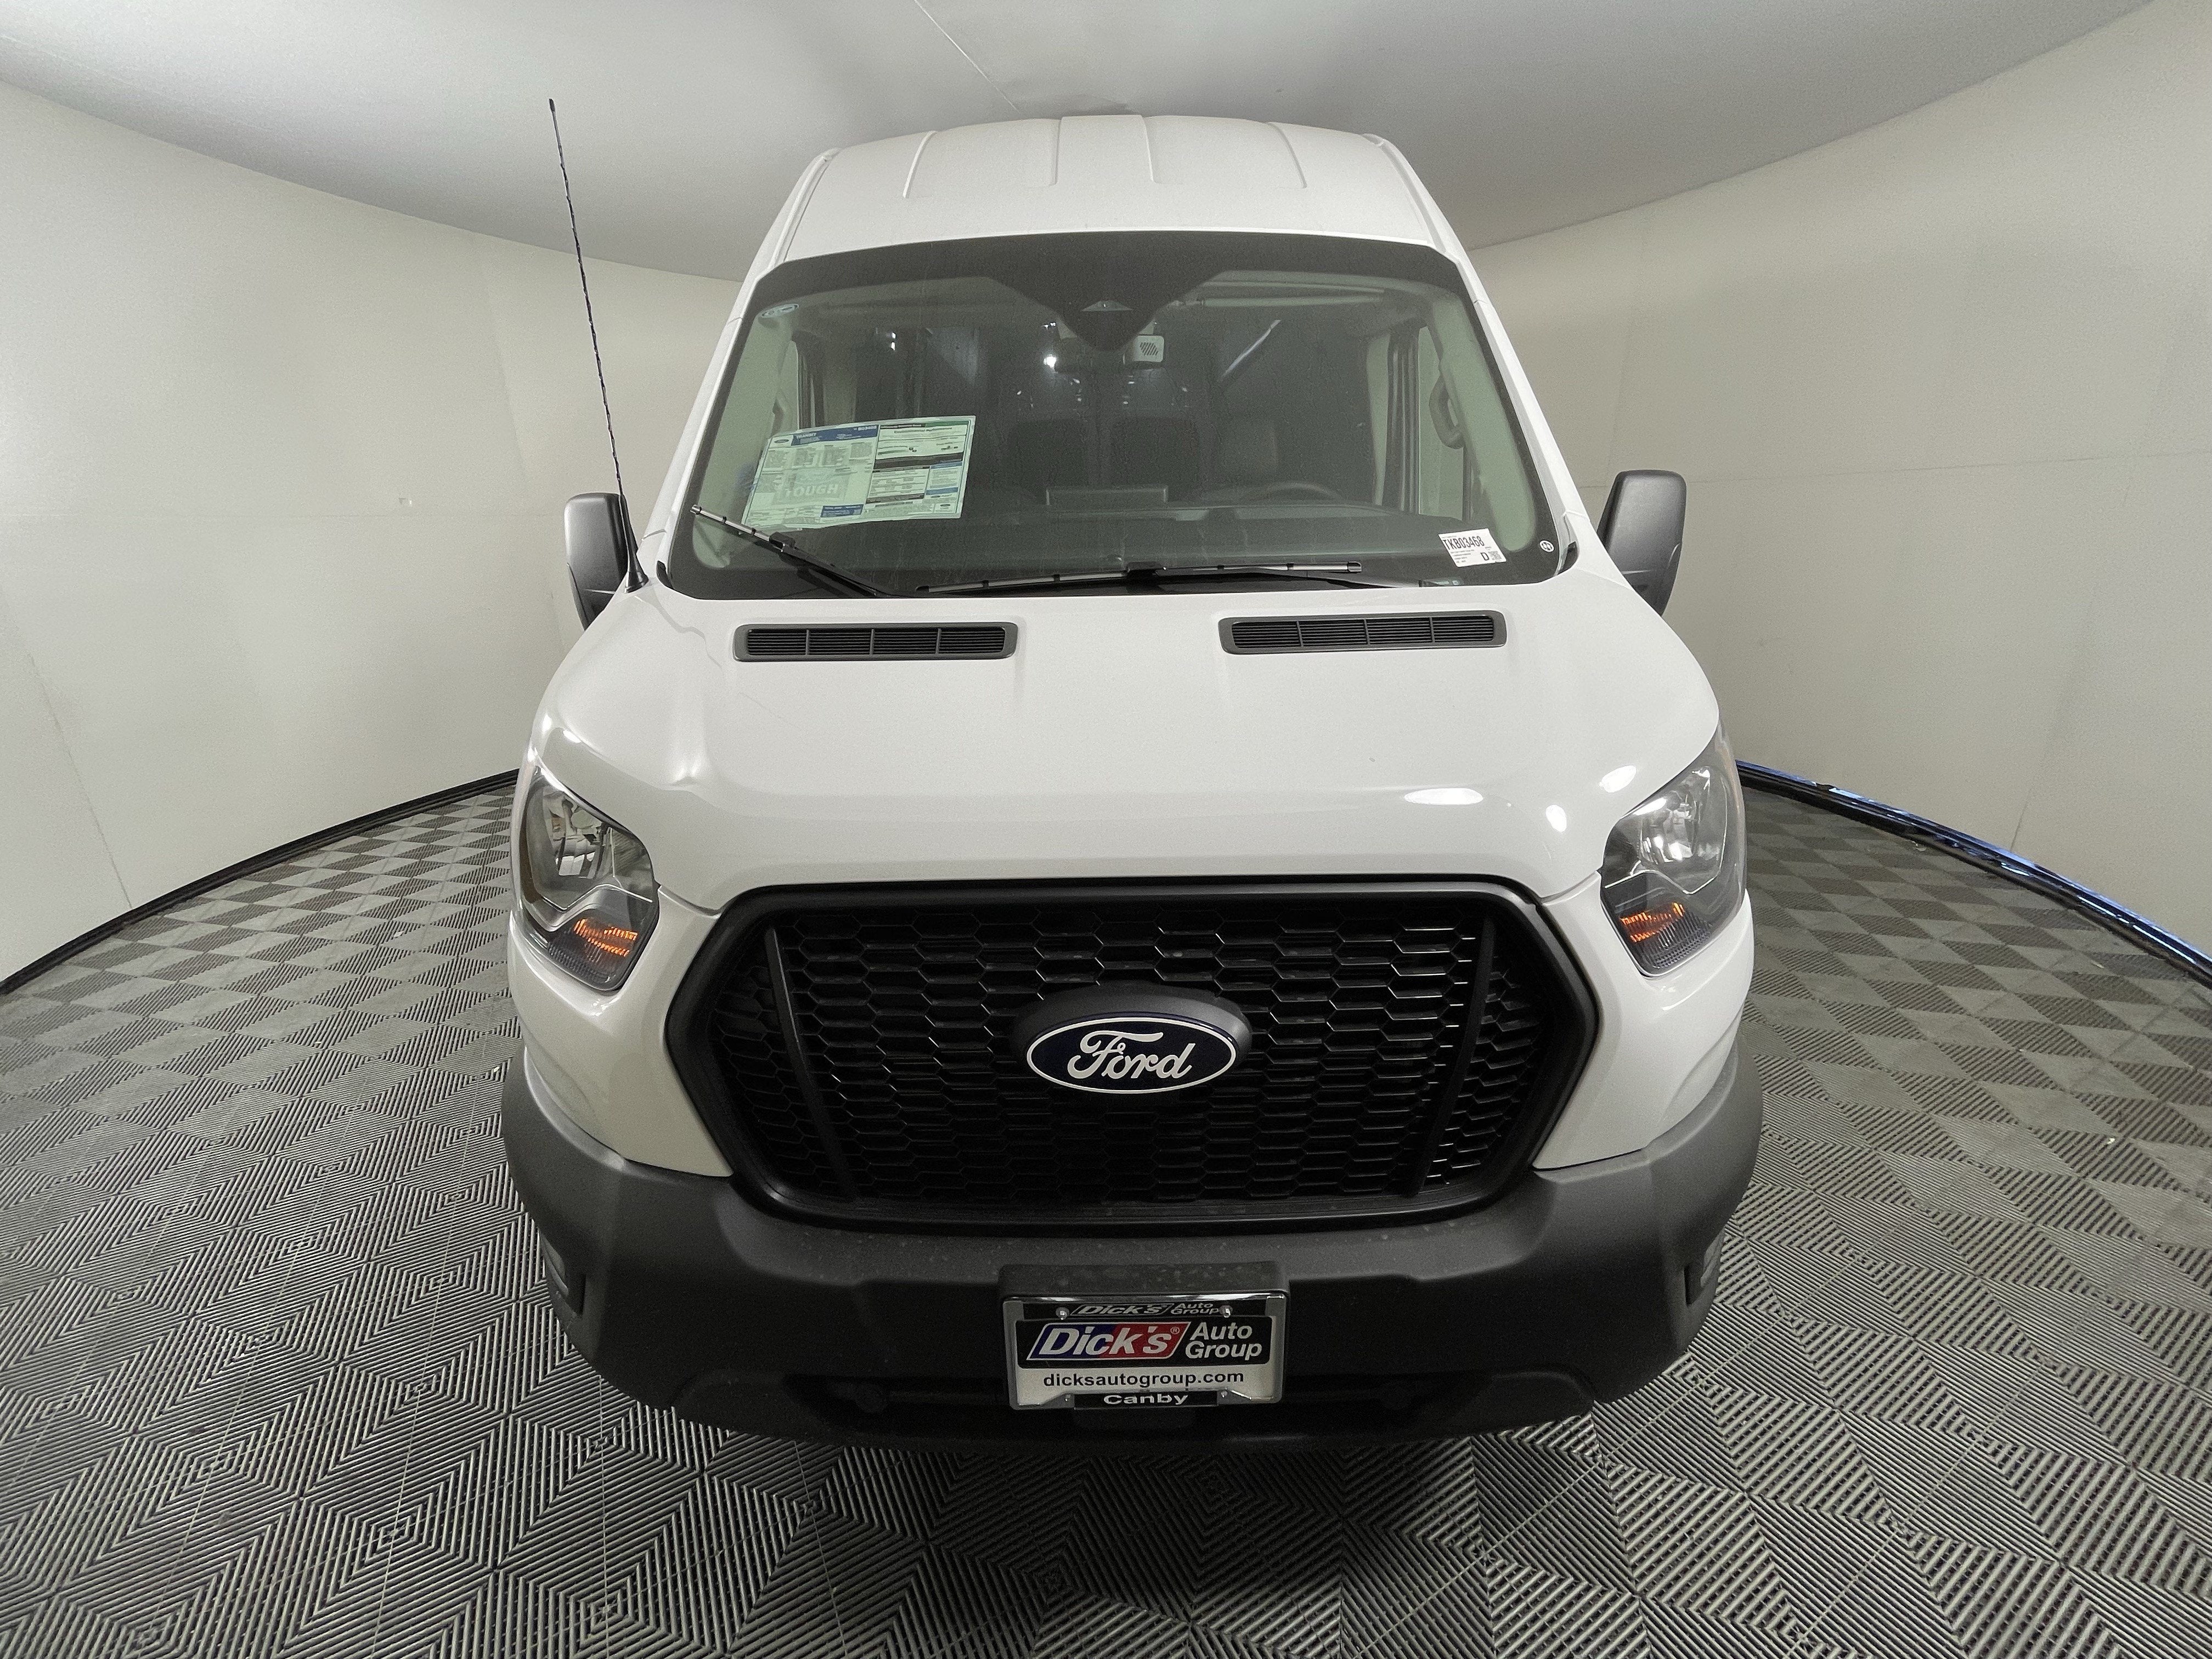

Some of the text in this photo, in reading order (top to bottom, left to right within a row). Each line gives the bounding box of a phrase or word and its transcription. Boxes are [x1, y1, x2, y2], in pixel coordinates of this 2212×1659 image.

[1442, 536, 1485, 550] TKB03468
[1480, 552, 1489, 561] D
[1067, 1030, 1195, 1079] Ford
[1077, 1304, 1163, 1314] Dick's
[1189, 1322, 1252, 1340] Auto
[1185, 1340, 1262, 1361] Group
[1043, 1371, 1244, 1388] dicksautogroup.com
[1103, 1392, 1188, 1406] Canby
